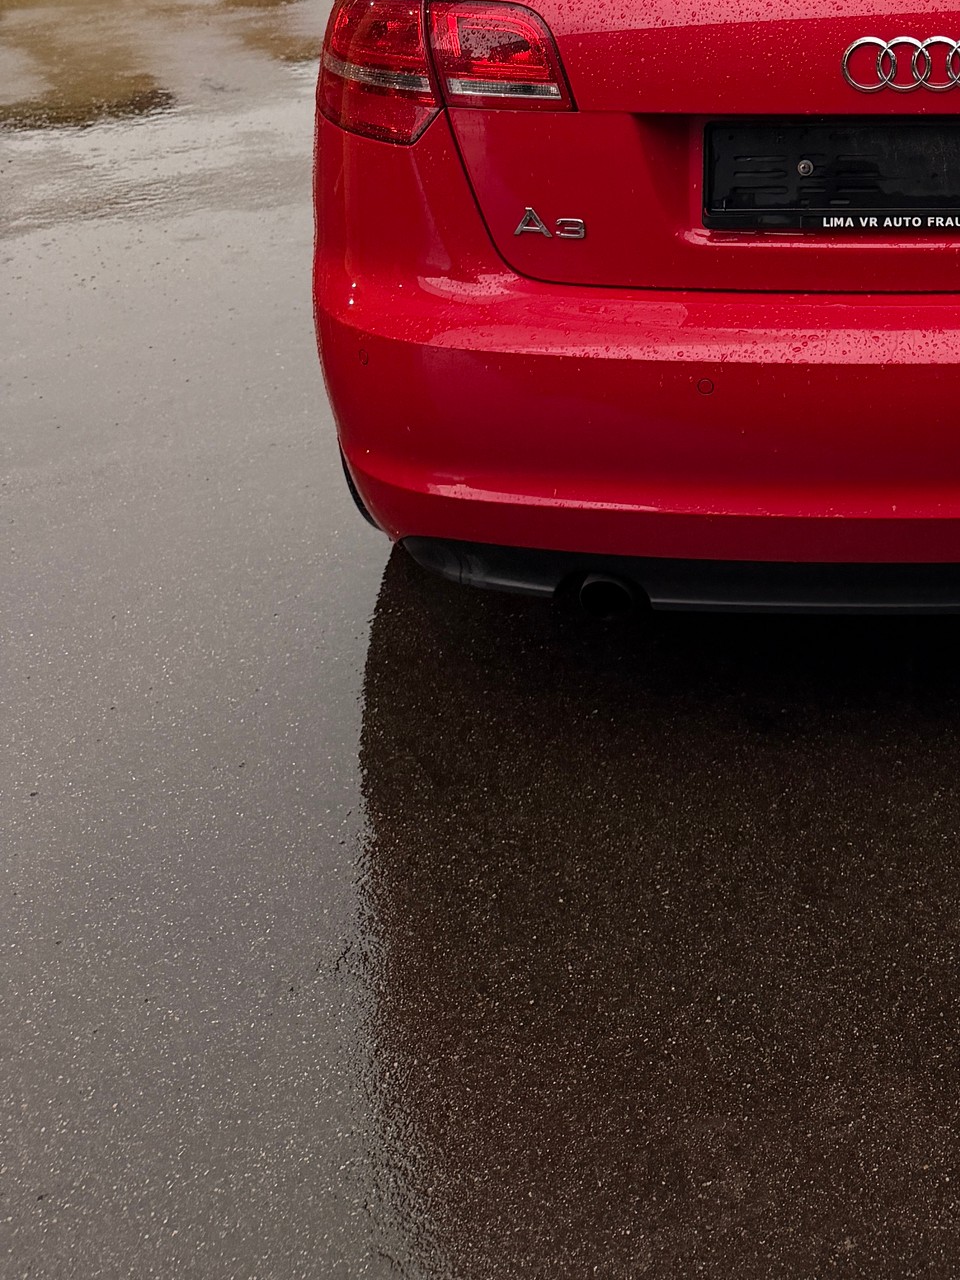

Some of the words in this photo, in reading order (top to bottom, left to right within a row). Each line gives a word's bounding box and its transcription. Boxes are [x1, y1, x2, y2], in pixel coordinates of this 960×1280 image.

[514, 207, 585, 239] A3
[822, 217, 854, 227] LIMA
[859, 217, 878, 227] VR
[883, 217, 922, 227] AUTO
